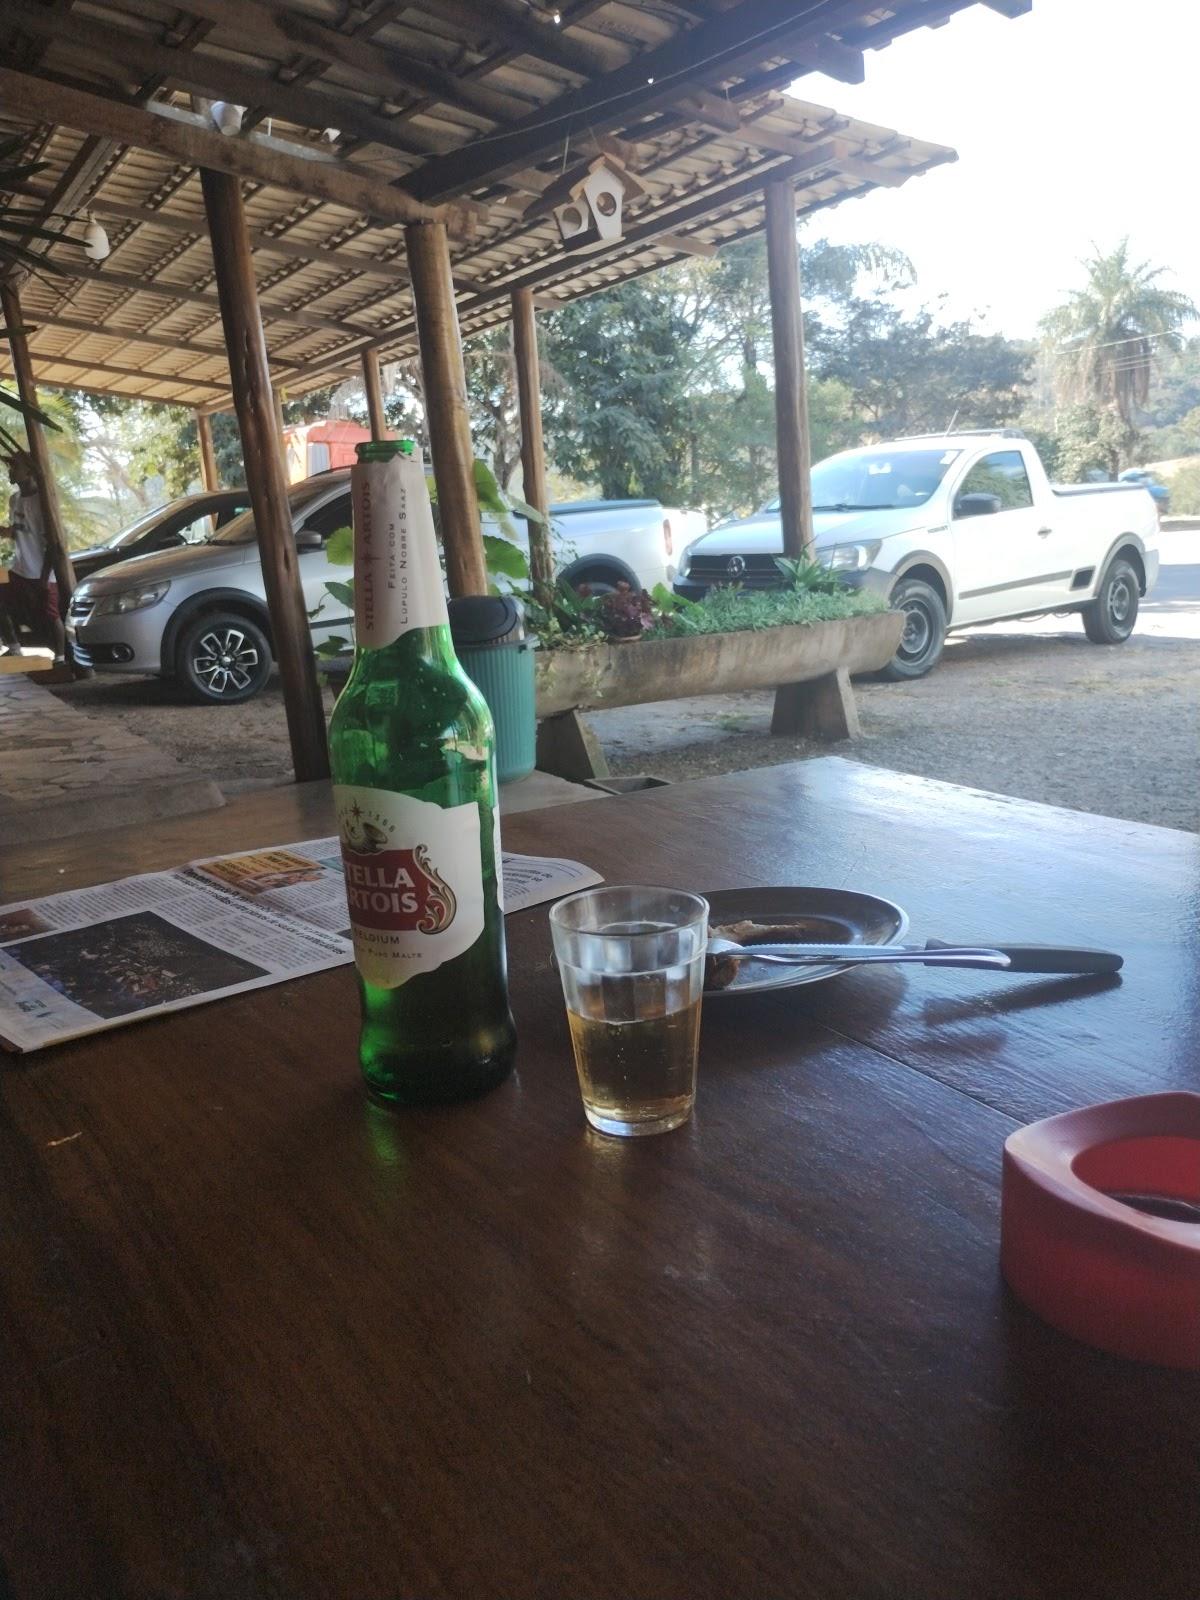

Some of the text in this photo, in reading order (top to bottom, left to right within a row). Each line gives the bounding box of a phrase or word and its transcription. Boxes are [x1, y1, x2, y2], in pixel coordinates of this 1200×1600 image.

[362, 481, 374, 631] STELLA ARTOIS
[344, 861, 416, 889] TELLA
